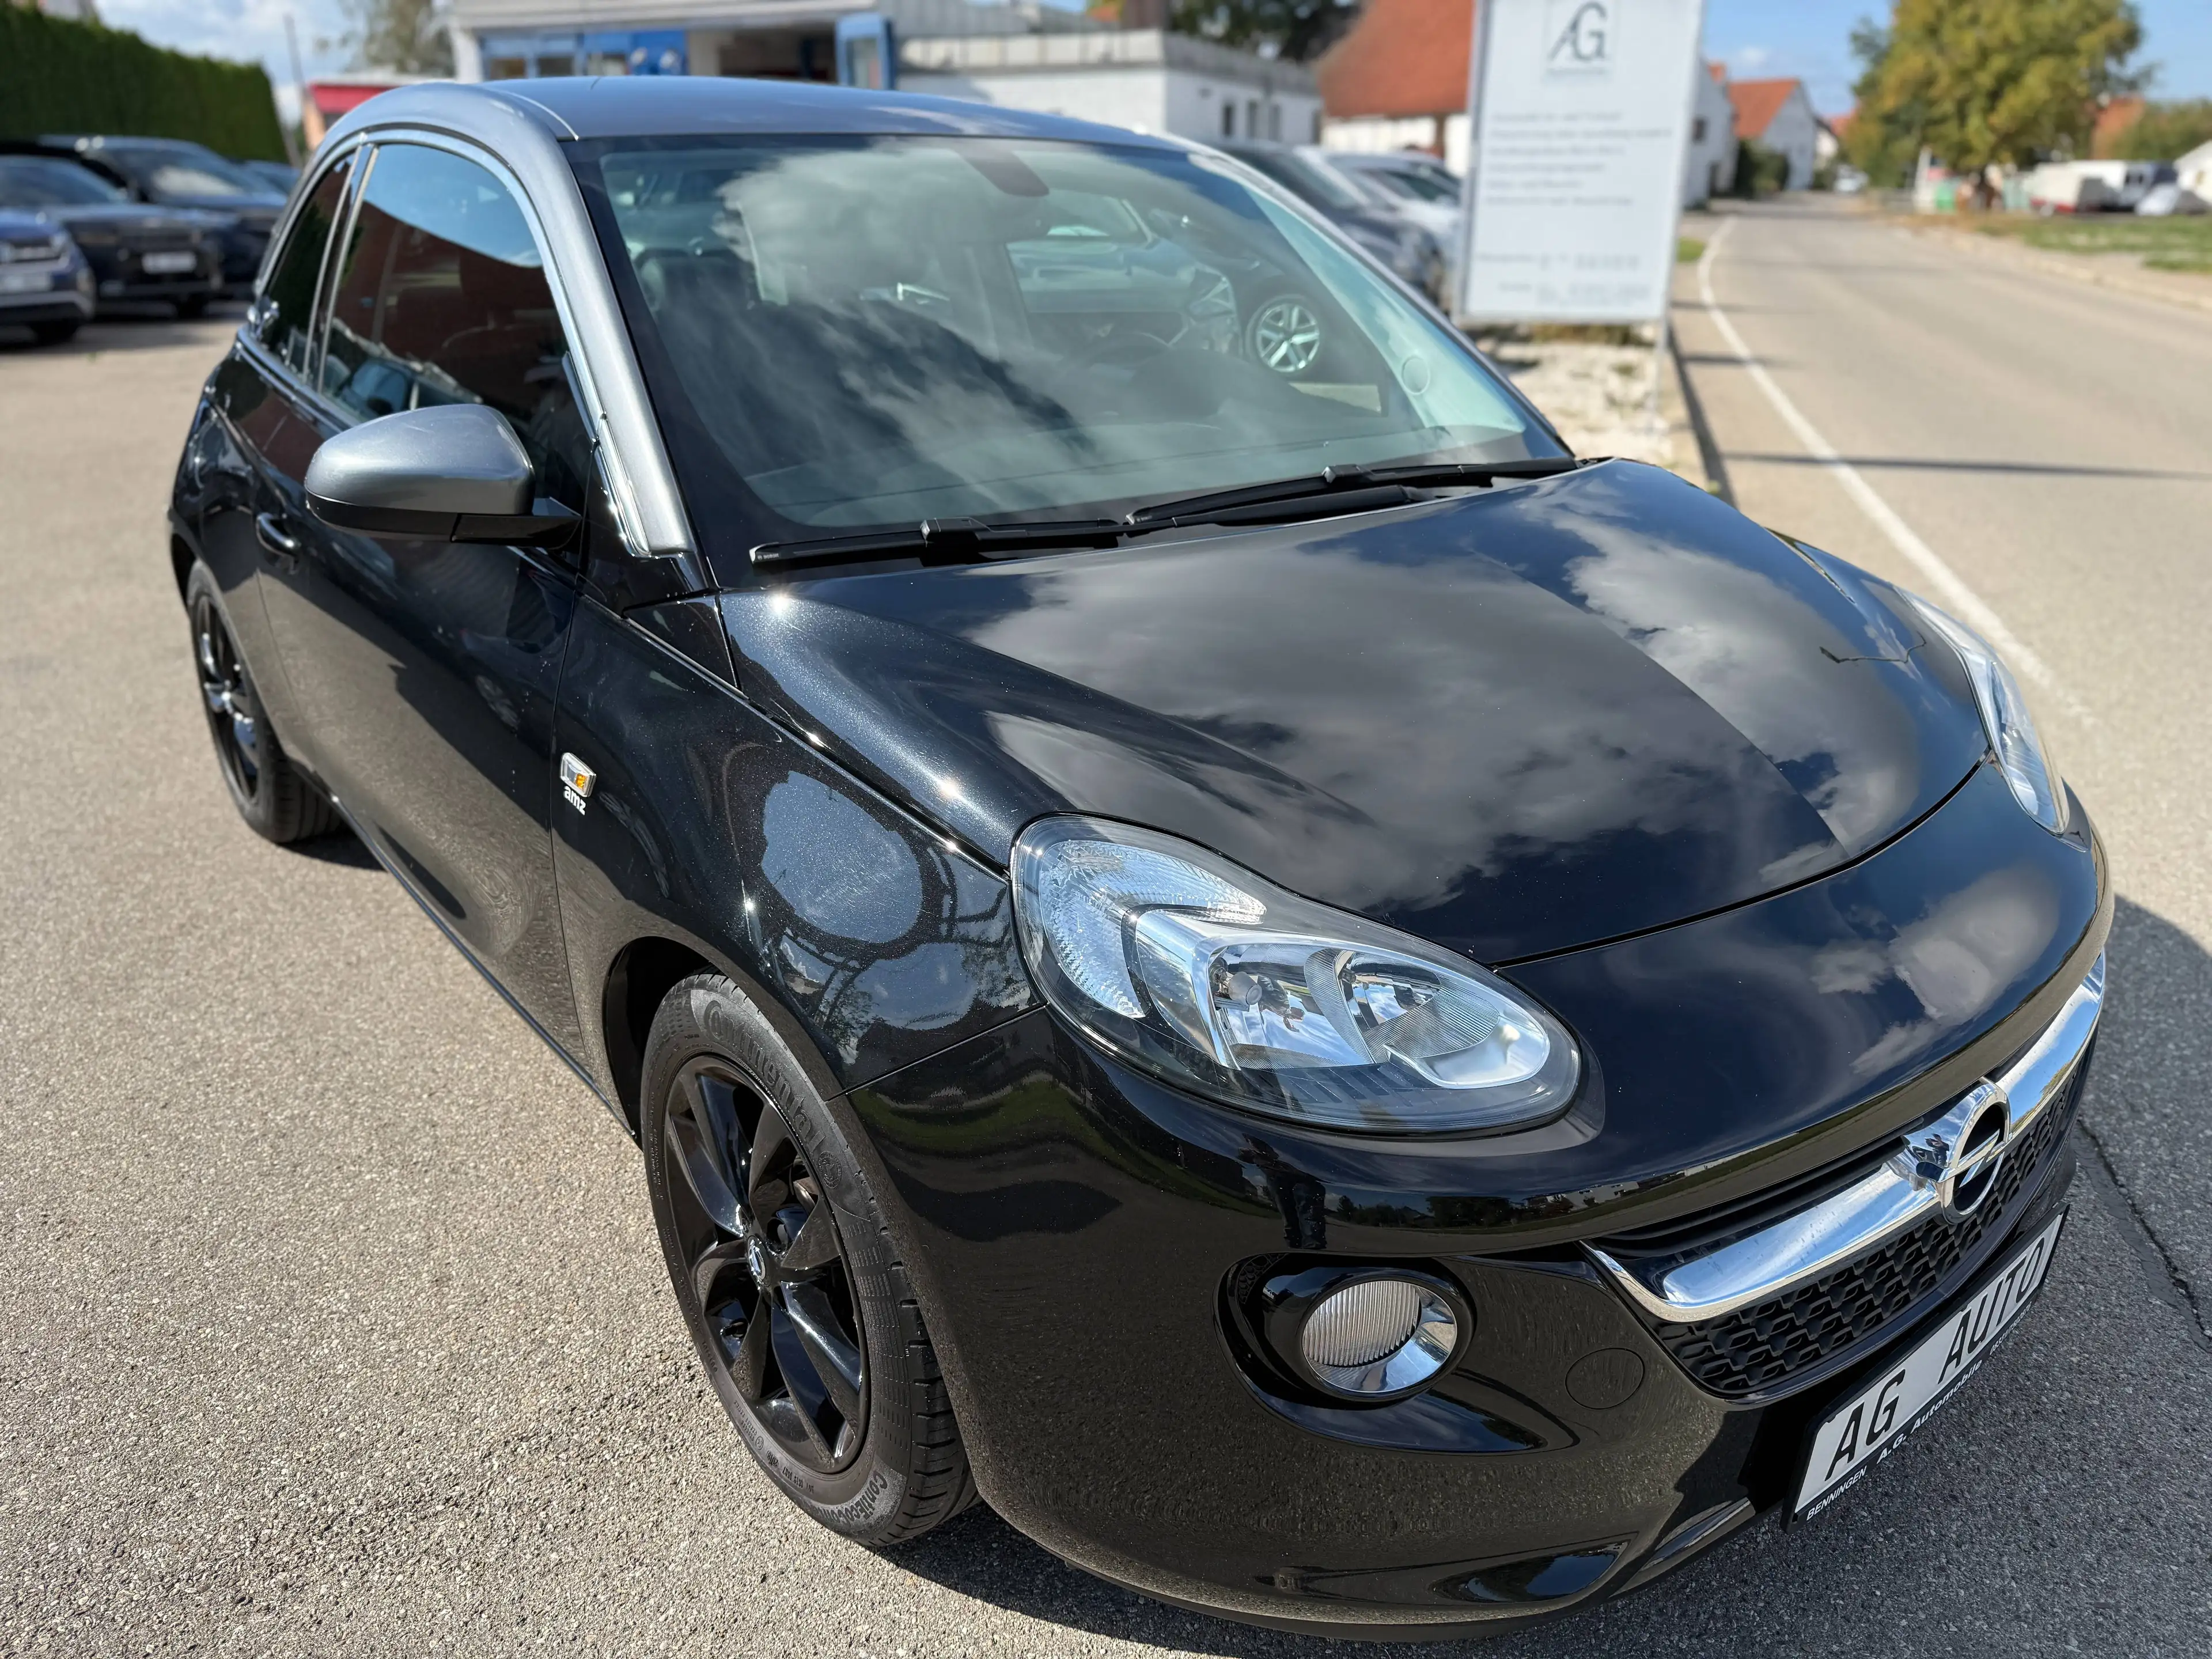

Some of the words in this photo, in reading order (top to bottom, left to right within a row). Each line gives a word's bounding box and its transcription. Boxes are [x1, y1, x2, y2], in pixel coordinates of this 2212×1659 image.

[703, 1000, 827, 1155] Continental
[1806, 1465, 1867, 1521] BENNINGEN
[1876, 1433, 1907, 1465] A.G.
[1911, 1359, 1982, 1433] Automobile
[1824, 1369, 1906, 1482] AG
[1938, 1237, 2045, 1385] AUTO
